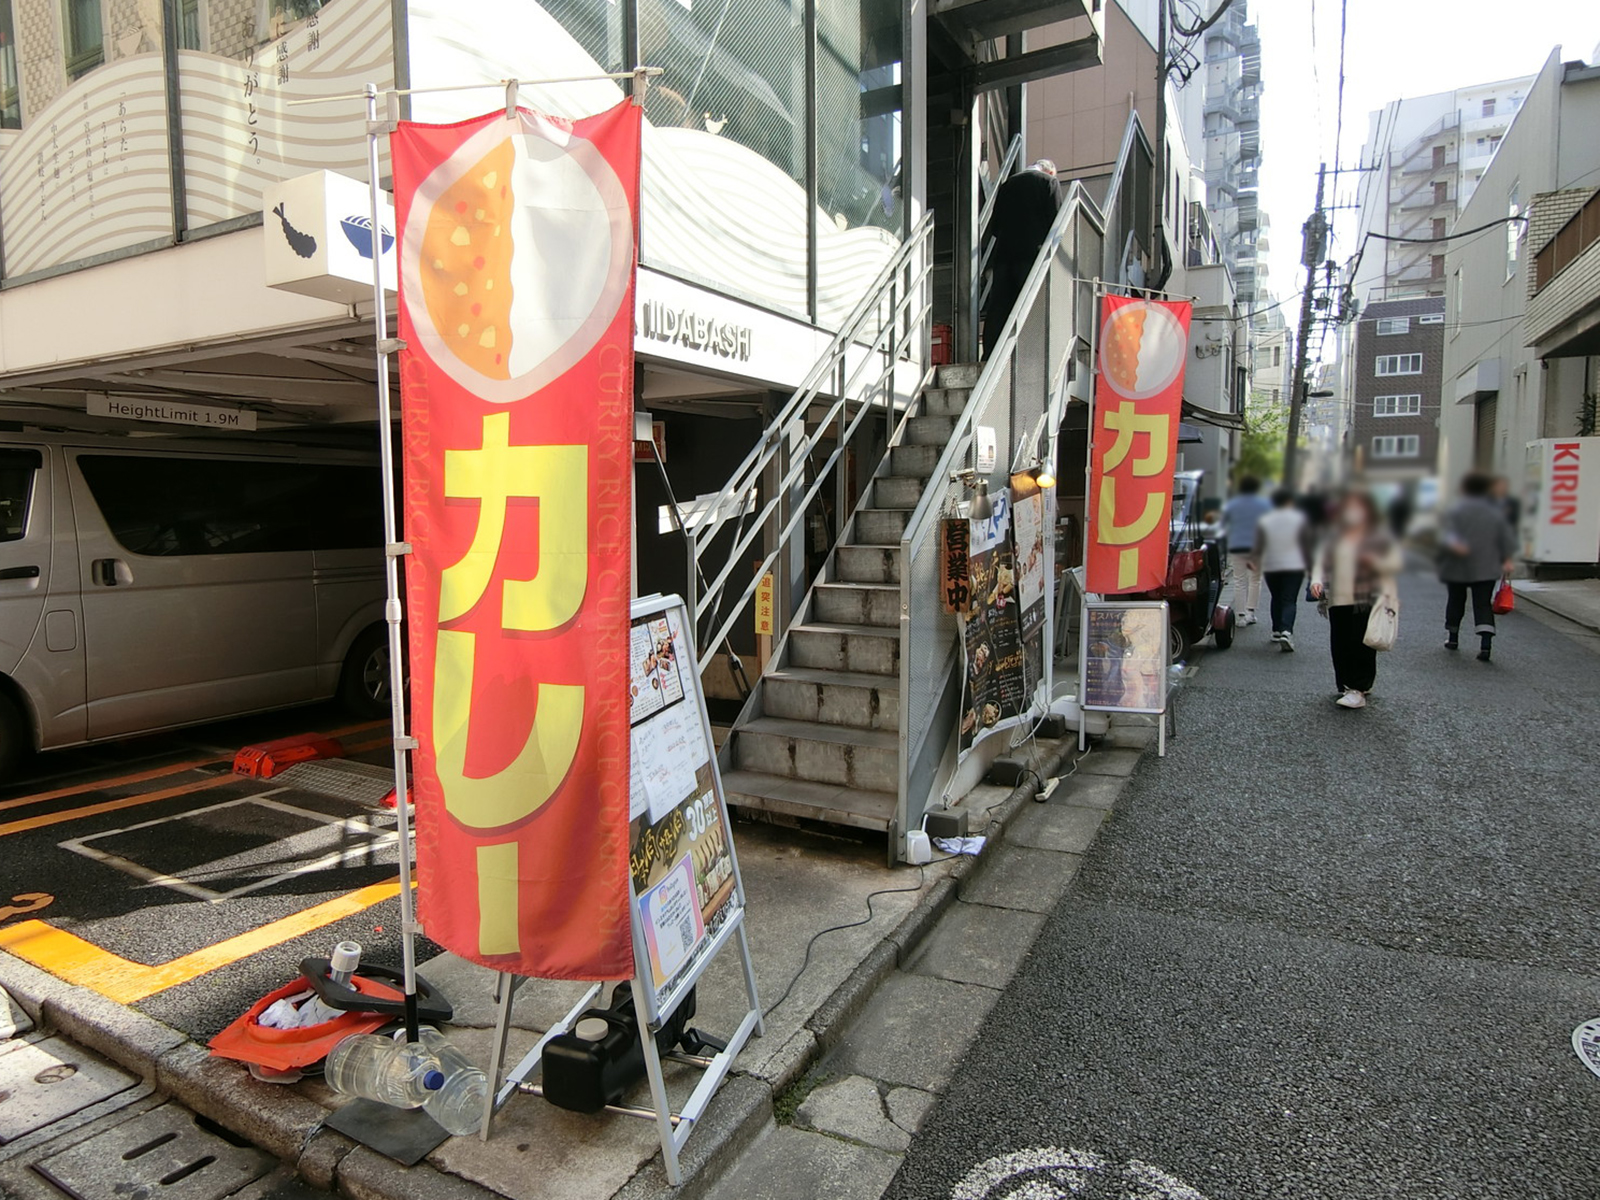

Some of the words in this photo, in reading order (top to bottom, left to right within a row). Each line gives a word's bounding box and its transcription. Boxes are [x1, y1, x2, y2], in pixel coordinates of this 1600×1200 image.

[241, 16, 261, 164] ありがとう。
[204, 412, 240, 426] 1.9M
[404, 356, 431, 474] CURRY
[597, 343, 625, 474] CURRY
[596, 478, 622, 557] RICE
[1097, 401, 1170, 590] カレー
[1549, 443, 1581, 525] KIRIN
[760, 577, 771, 631] 追突注意
[946, 521, 969, 612] 営業中
[597, 569, 622, 688] CURRY
[432, 411, 588, 956] カレー
[597, 699, 621, 771] RICE
[599, 781, 621, 896] CURRY
[686, 799, 706, 841] 30
